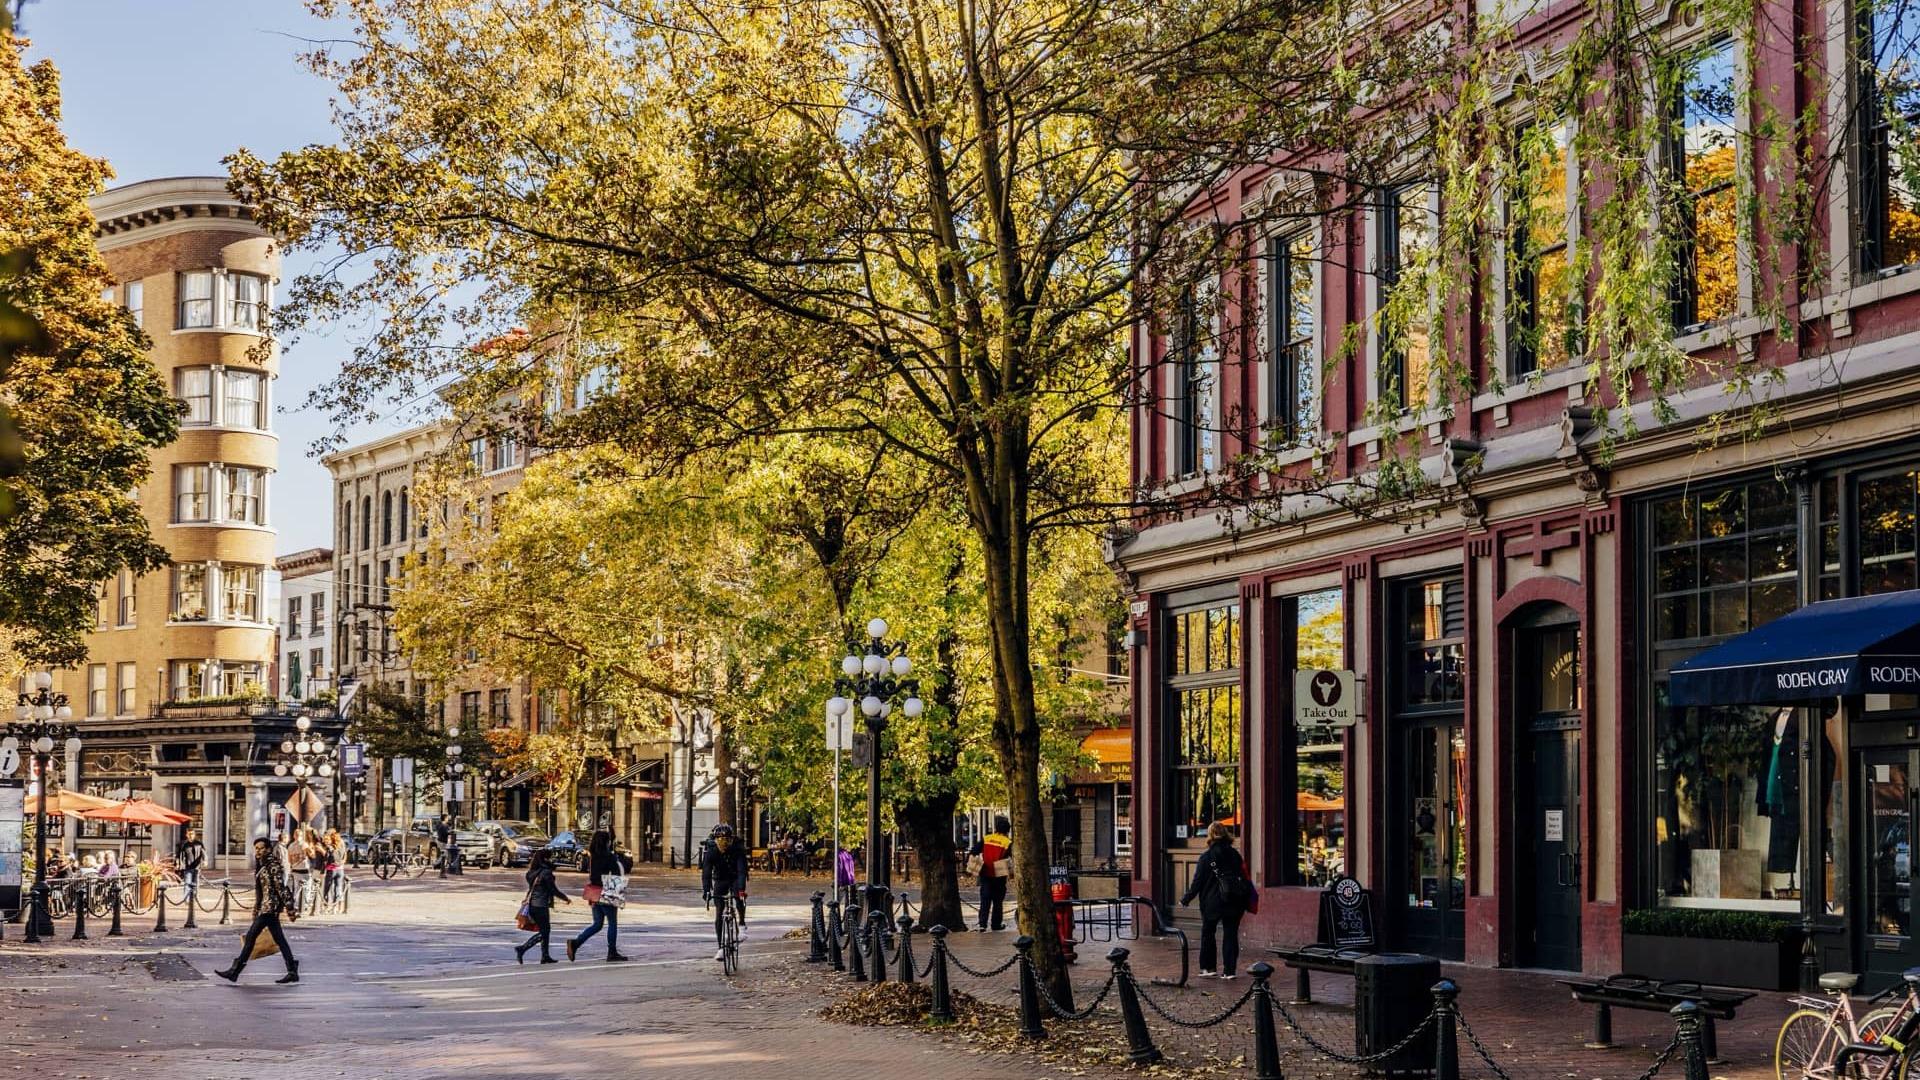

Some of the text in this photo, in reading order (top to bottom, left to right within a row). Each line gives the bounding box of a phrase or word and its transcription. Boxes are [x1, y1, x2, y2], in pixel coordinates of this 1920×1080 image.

[1777, 668, 1850, 689] RODEN GRAY
[1302, 707, 1348, 718] Take Out
[1074, 787, 1096, 797] ATM
